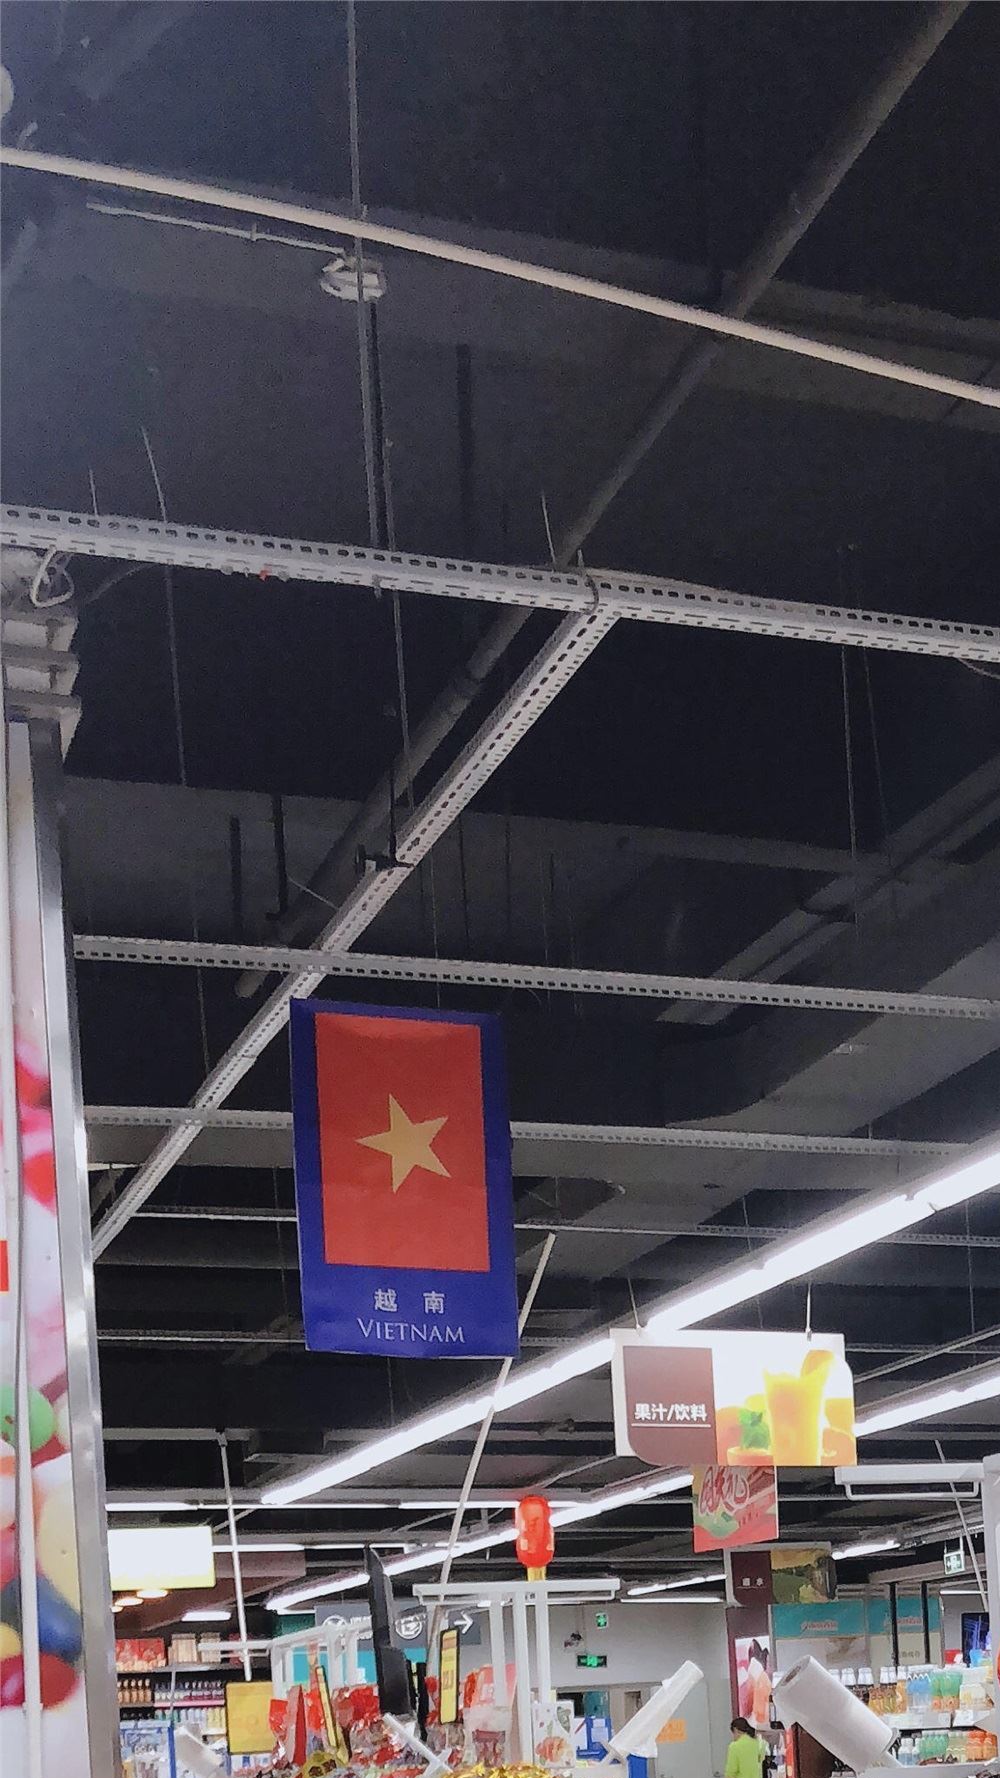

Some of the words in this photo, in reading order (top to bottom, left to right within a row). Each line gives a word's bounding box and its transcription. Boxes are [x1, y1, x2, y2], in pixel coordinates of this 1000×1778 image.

[374, 1288, 445, 1314] 越南
[357, 1318, 465, 1343] VIETNAM
[634, 1403, 707, 1422] 果汁/饮料
